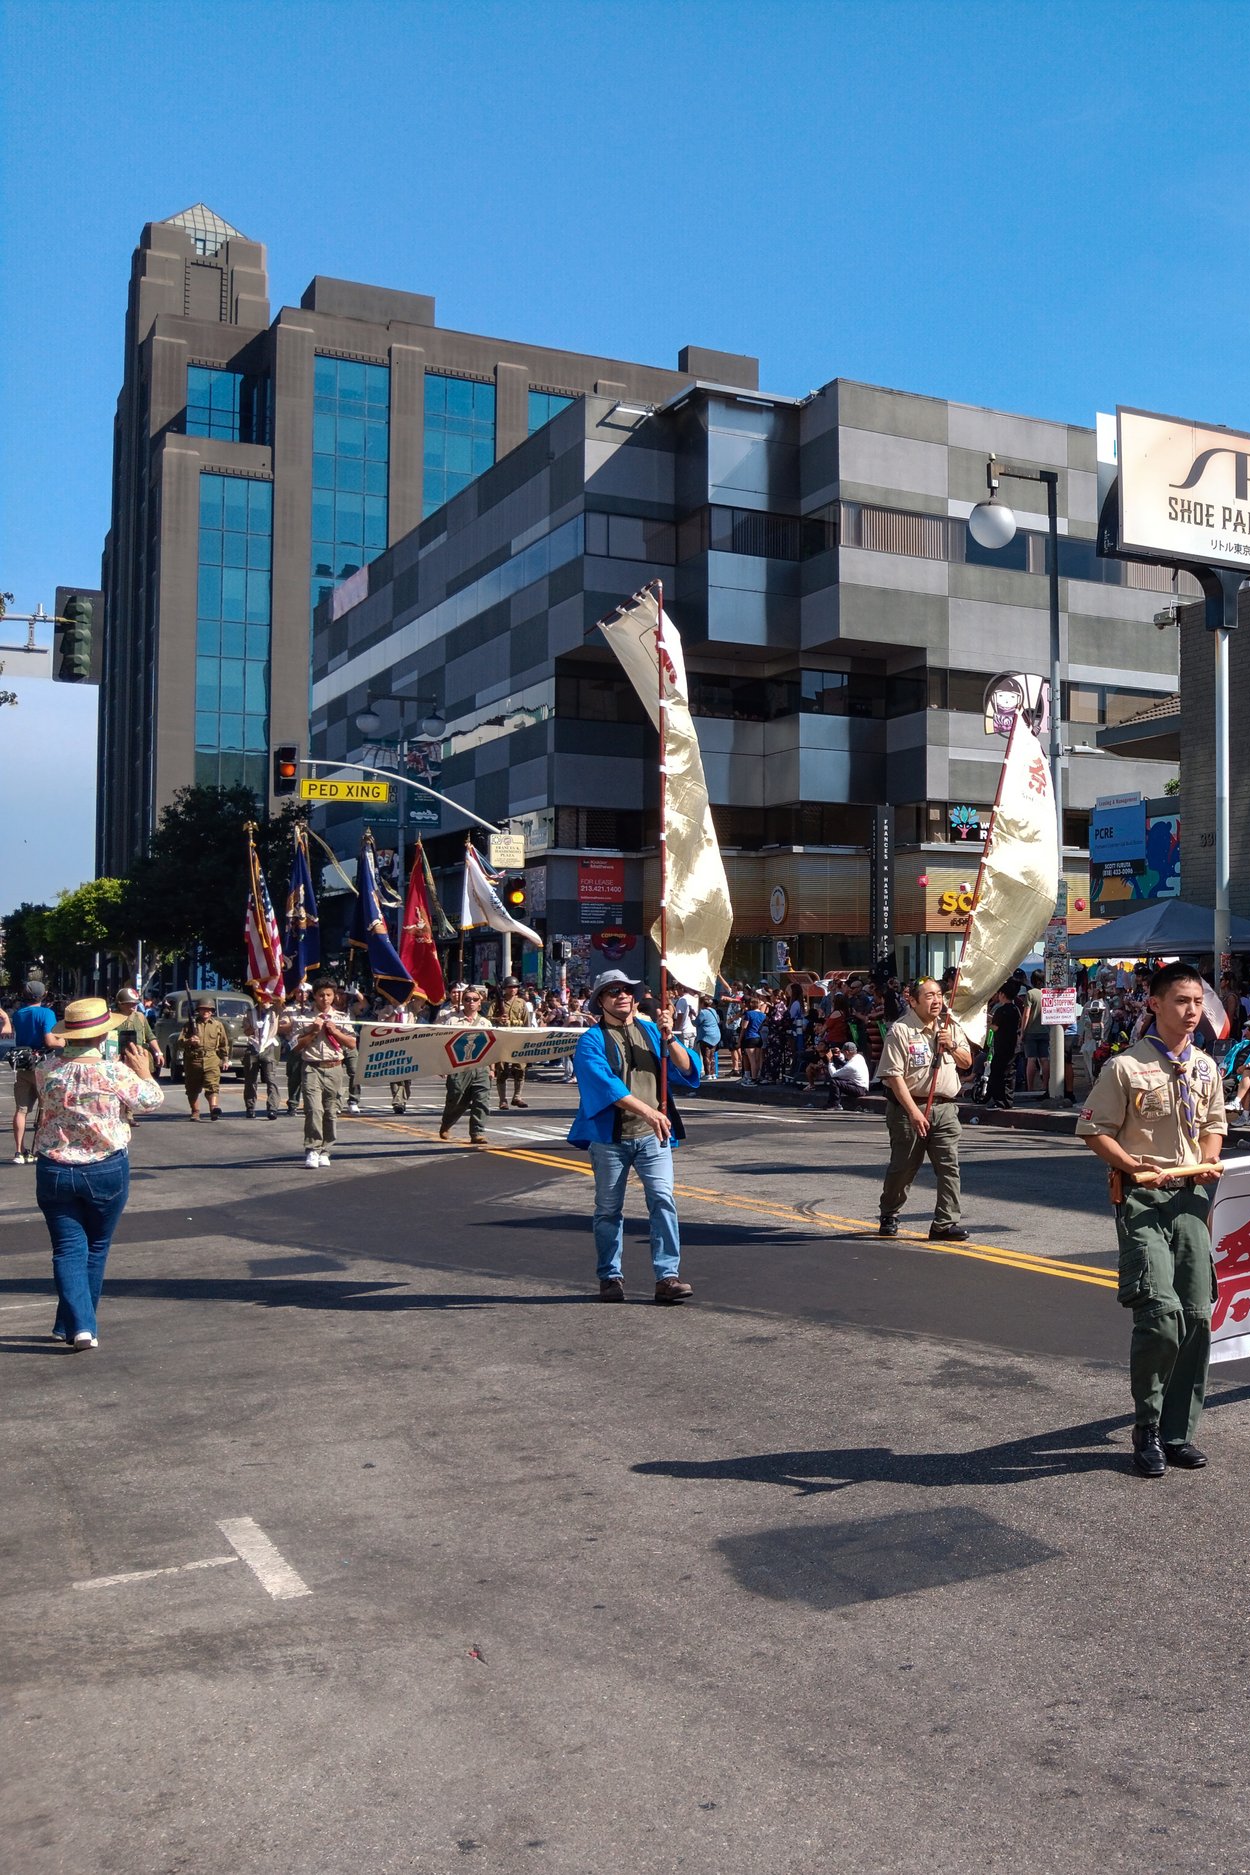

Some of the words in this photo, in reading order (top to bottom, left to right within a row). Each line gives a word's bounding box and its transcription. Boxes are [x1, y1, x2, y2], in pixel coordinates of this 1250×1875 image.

[1168, 496, 1215, 529] SHOE
[308, 783, 339, 797] PED
[345, 785, 381, 798] XING
[1095, 827, 1114, 840] PCRE
[580, 885, 622, 893] 213.421.1400
[1043, 998, 1053, 1007] NO
[1053, 998, 1074, 1006] STOPPING
[369, 1035, 411, 1047] Japanese
[411, 1031, 454, 1040] American
[523, 1037, 578, 1049] Regimenta
[368, 1049, 406, 1063] 100th
[511, 1047, 553, 1058] Combat
[365, 1056, 413, 1071] Infantry
[364, 1064, 419, 1079] Battalion
